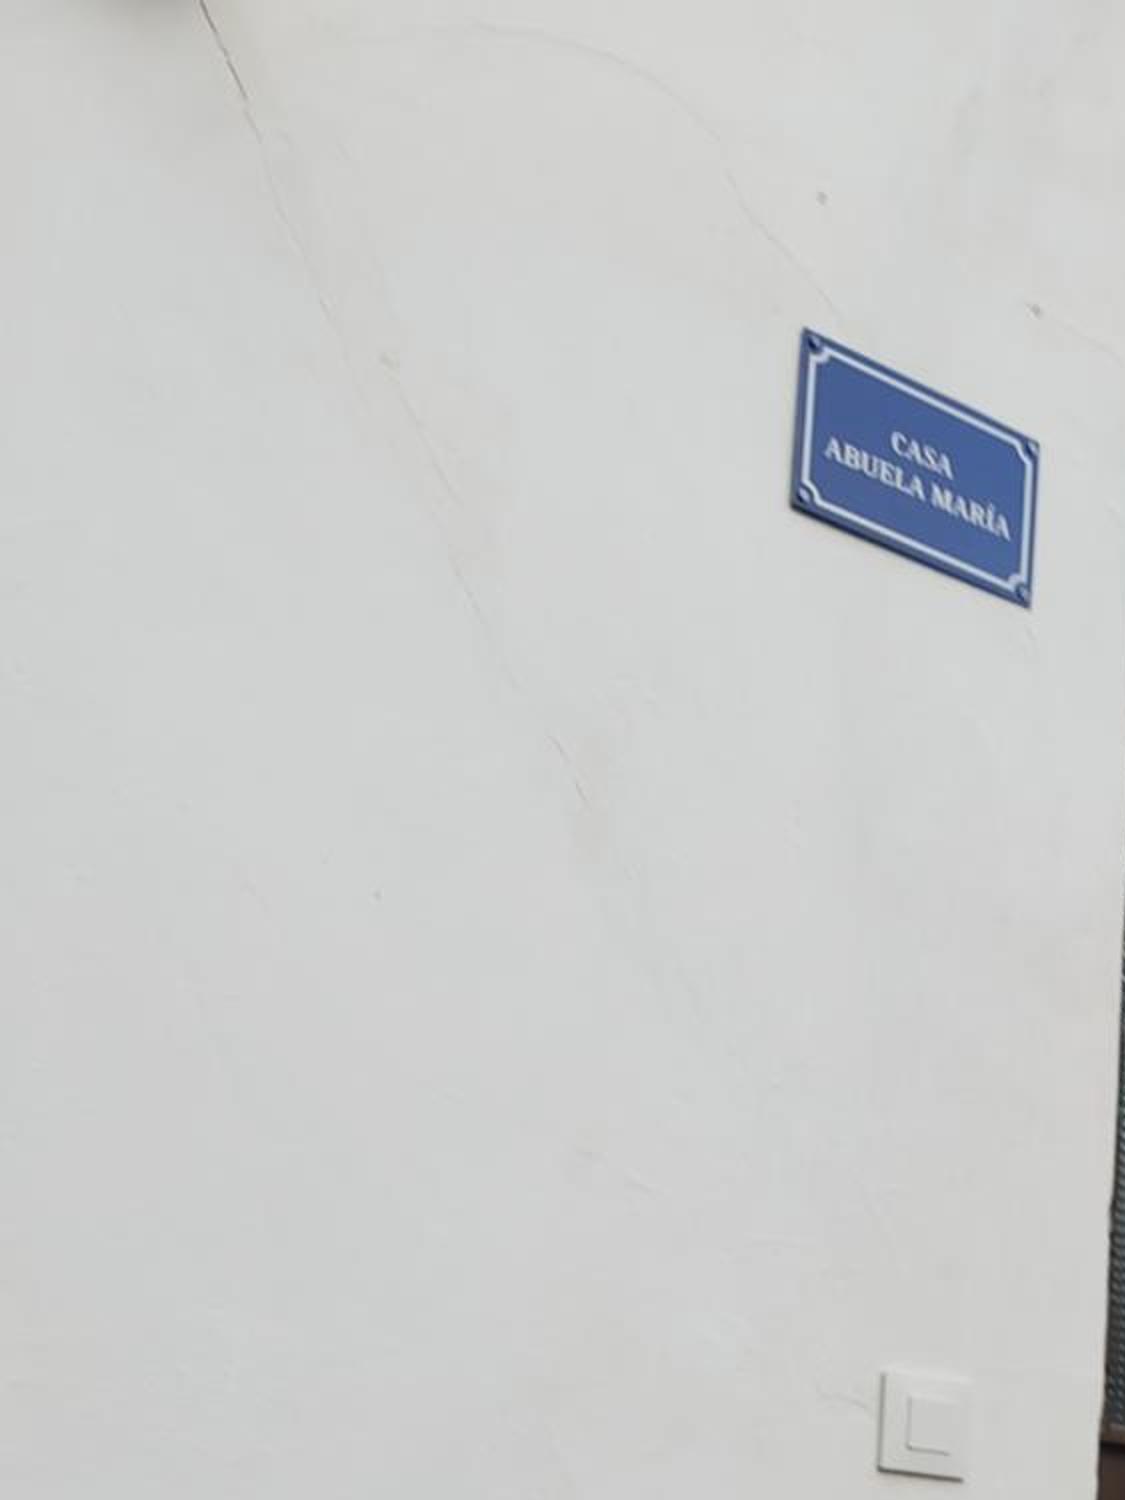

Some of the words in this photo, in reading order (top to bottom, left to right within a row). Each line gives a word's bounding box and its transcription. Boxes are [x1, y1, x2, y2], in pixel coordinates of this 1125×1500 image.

[825, 437, 925, 500] ABUELA
[931, 484, 1010, 541] MARÍA
[890, 431, 953, 479] CASA
